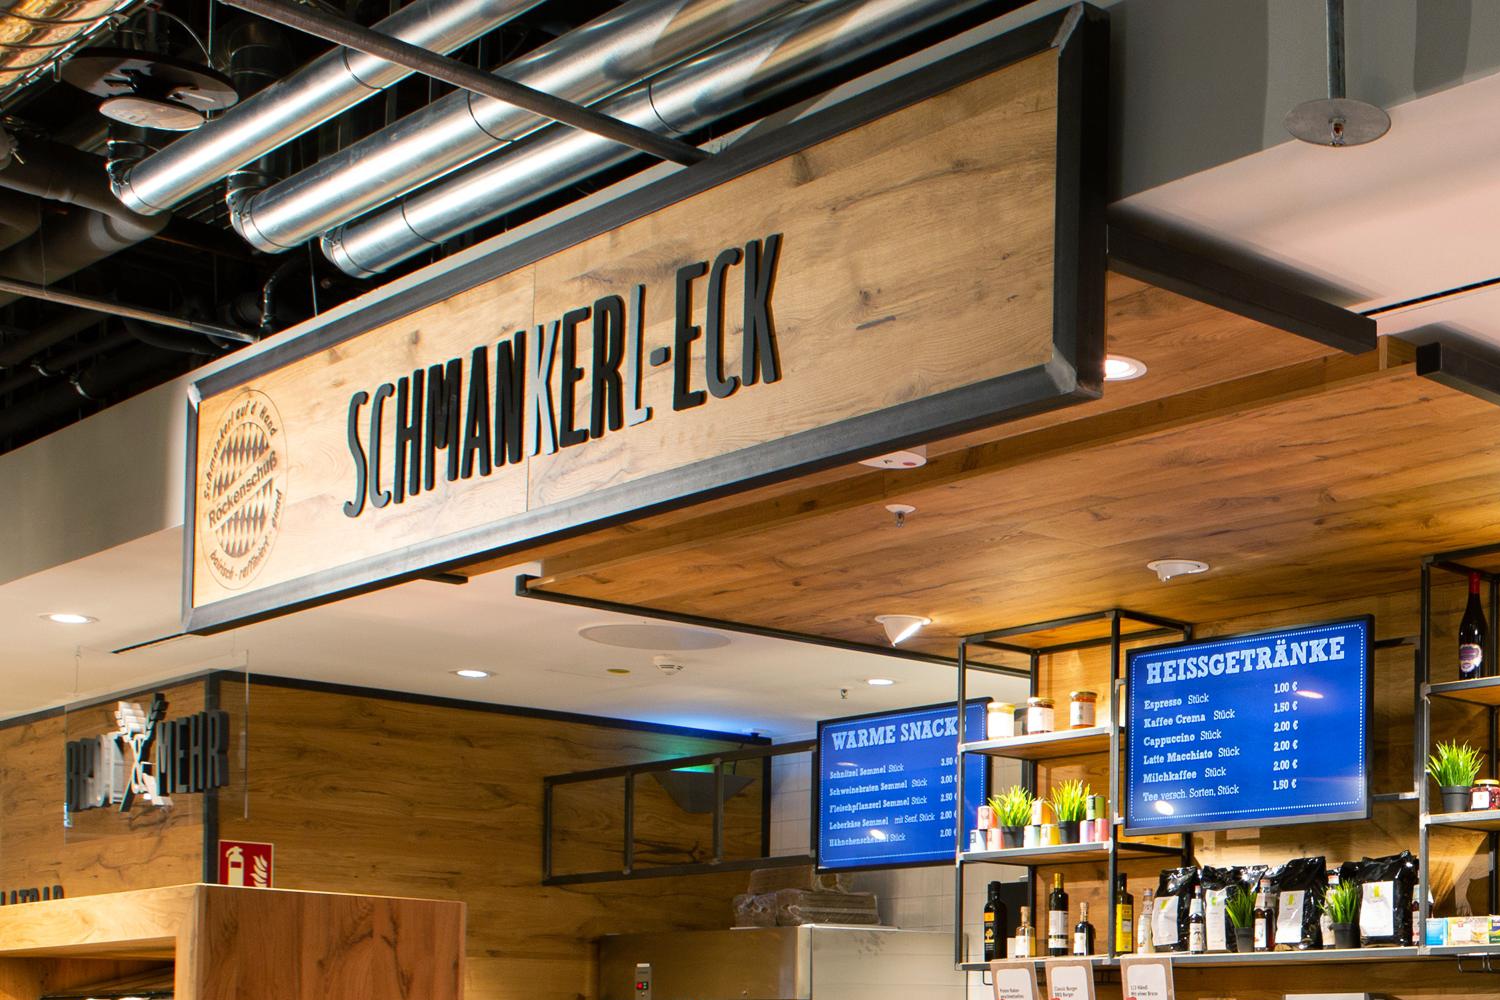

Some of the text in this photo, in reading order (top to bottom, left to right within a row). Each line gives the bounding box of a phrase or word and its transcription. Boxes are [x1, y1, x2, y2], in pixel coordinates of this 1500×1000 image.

[343, 232, 784, 519] SCHMANKERL-ECK
[208, 451, 278, 528] Röckenschuß
[1147, 637, 1345, 684] HEISSGETRÄNKE
[1274, 682, 1290, 693] 1.00
[1144, 693, 1209, 711] Espresso Stück
[1274, 702, 1290, 713] 1.50
[1144, 709, 1235, 729] Kaffee Crema Stück
[1274, 722, 1290, 733] 2.00
[901, 715, 967, 742] SNACK
[1144, 729, 1221, 748] Cappuccino Stück
[1273, 741, 1290, 752] 2.00
[156, 711, 229, 797] MEHR
[1144, 746, 1240, 765] Latte Macchiato Stück
[829, 763, 904, 780] Schnitzel Semmel Stück
[1273, 760, 1290, 771] 2.00
[1143, 766, 1226, 783] Milchkaffee Stück
[880, 781, 907, 791] Semmel
[911, 778, 928, 788] Stück
[1273, 780, 1289, 790] 1.50
[883, 797, 909, 807] Semmel
[911, 796, 928, 805] Stück
[1143, 791, 1158, 802] Tee
[1217, 785, 1239, 796] Stück
[862, 817, 888, 828] Semmel
[919, 813, 935, 822] Stück
